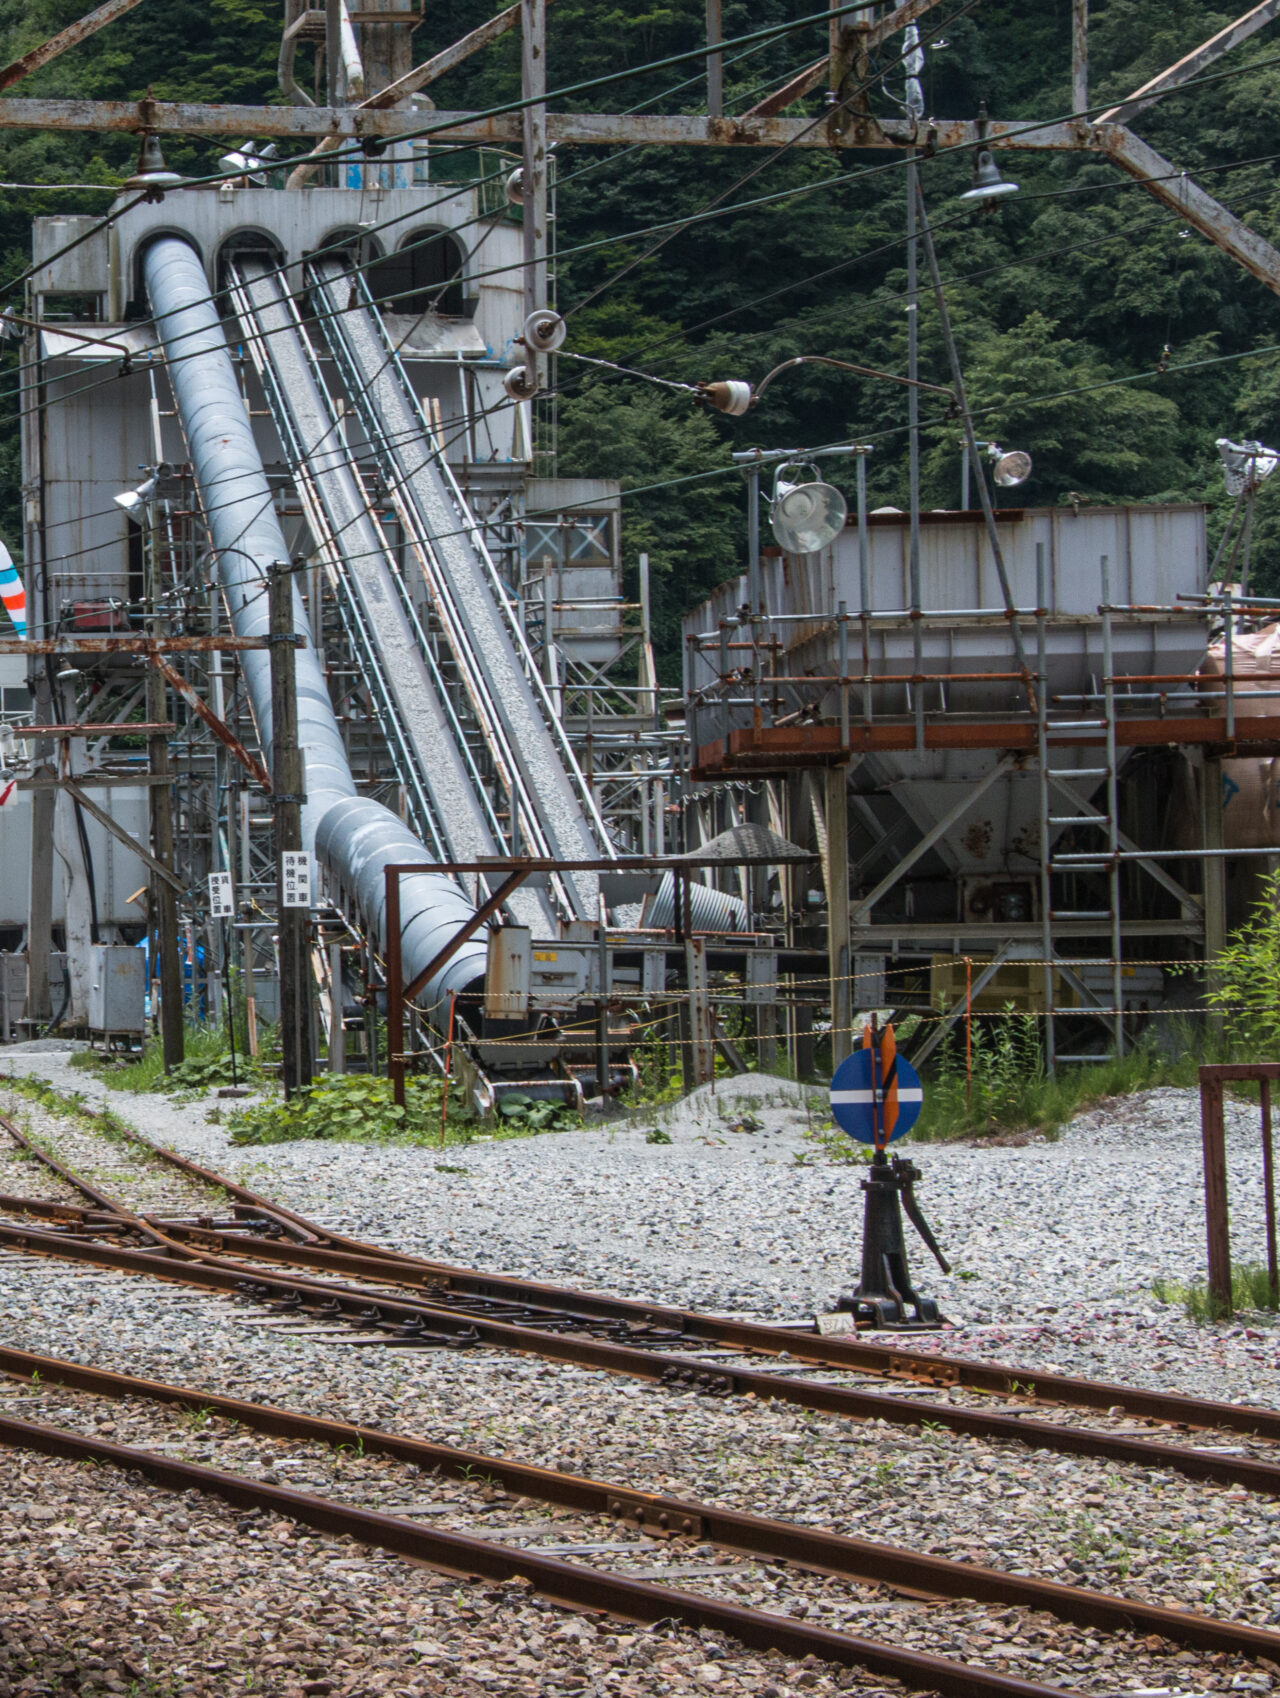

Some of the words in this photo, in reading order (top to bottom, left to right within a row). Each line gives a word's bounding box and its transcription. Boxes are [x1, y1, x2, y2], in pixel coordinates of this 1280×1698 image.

[285, 856, 296, 903] 待機位置
[297, 856, 308, 902] 機関車
